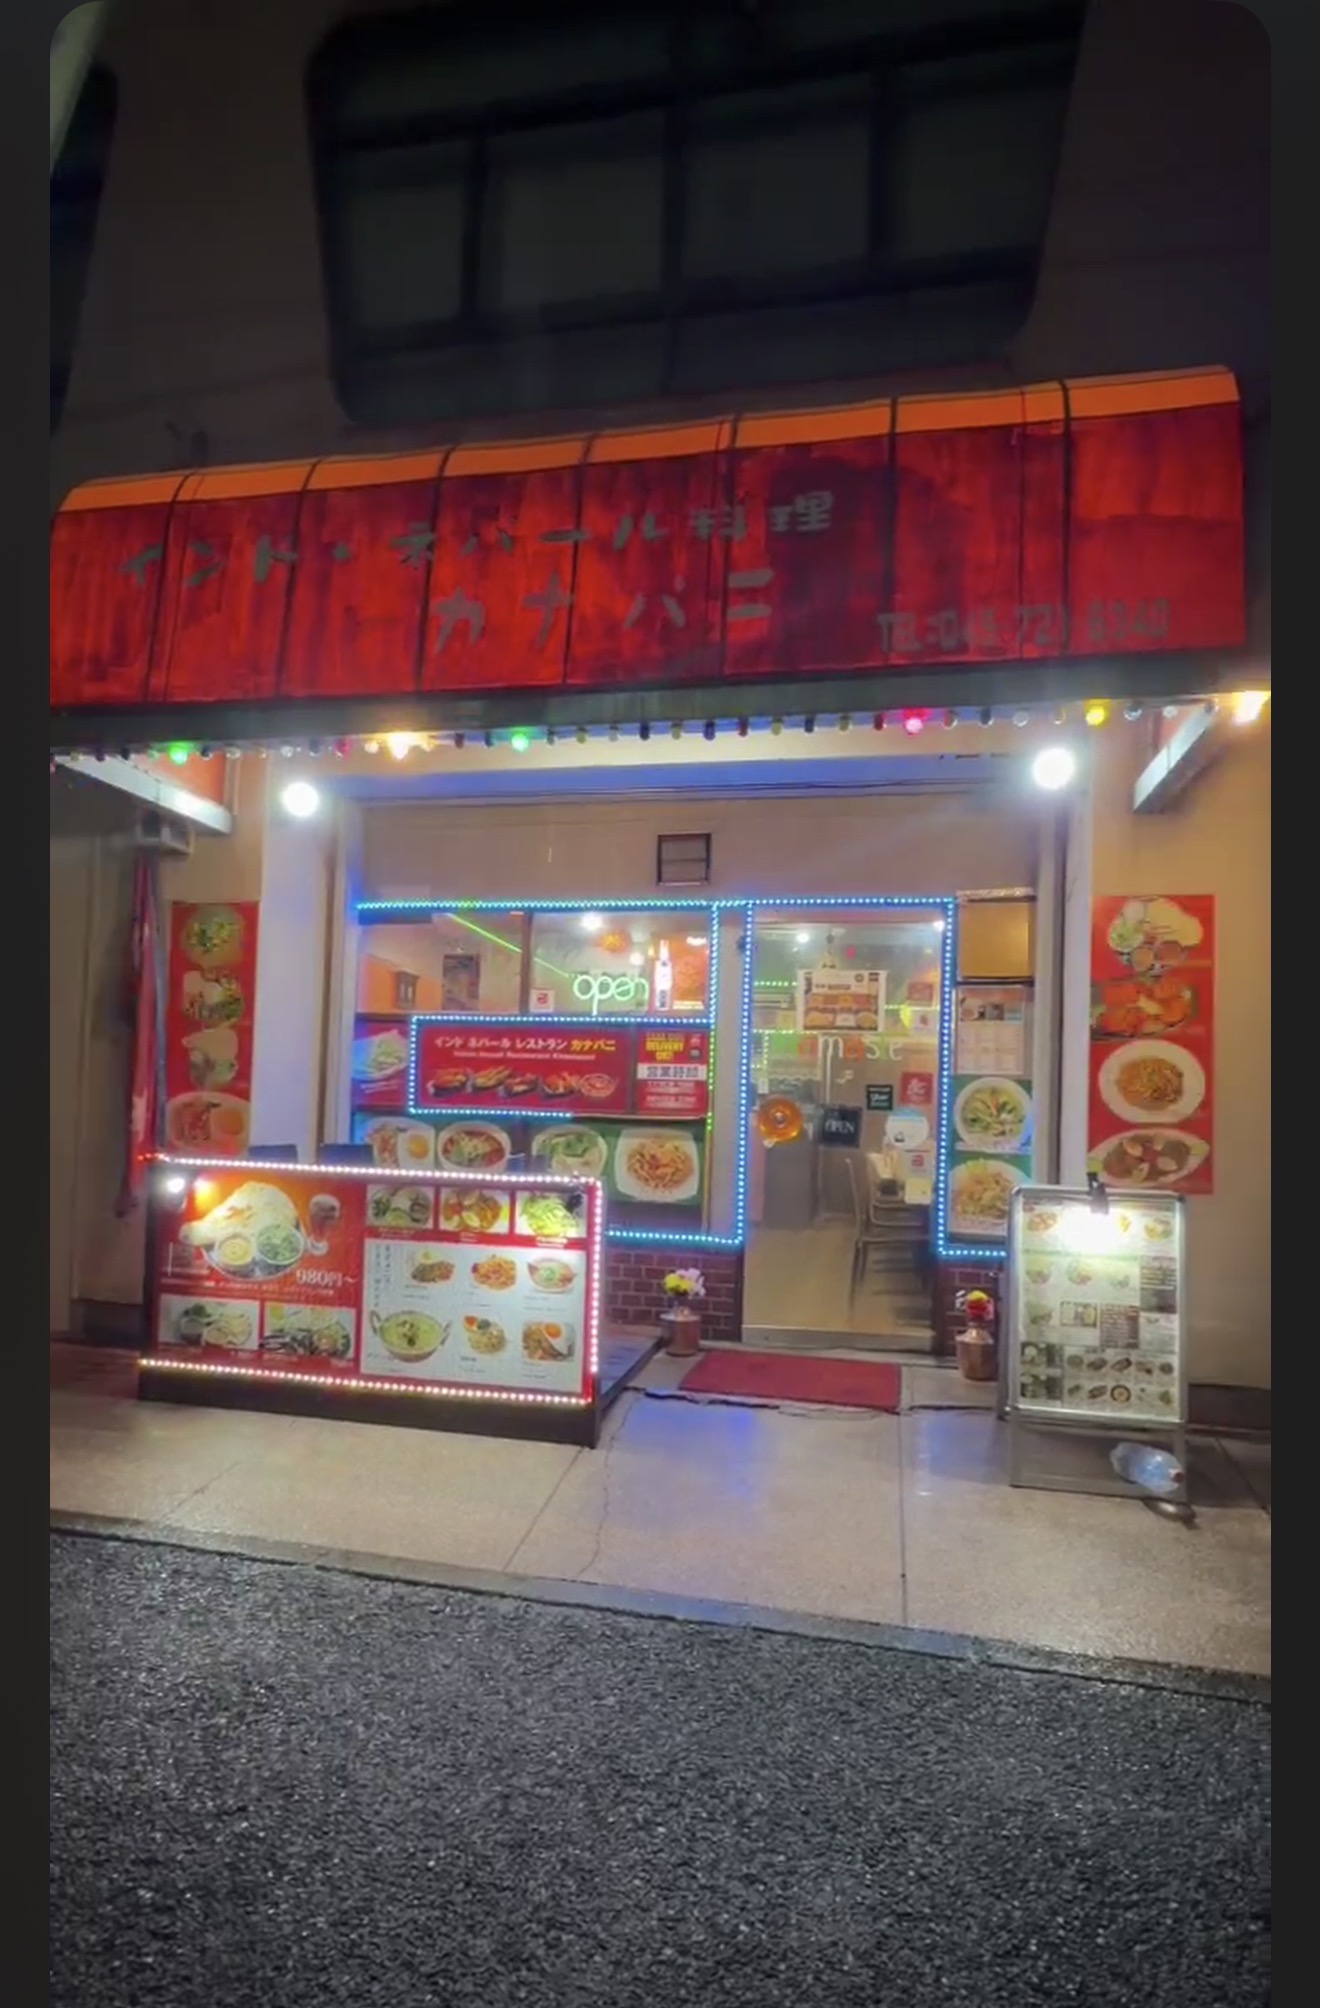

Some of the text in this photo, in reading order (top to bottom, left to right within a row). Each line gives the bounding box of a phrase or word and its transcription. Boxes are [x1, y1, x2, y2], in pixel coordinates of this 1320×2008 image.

[572, 975, 650, 1016] open
[515, 1038, 568, 1050] レストラン
[824, 1118, 855, 1134] OPEN
